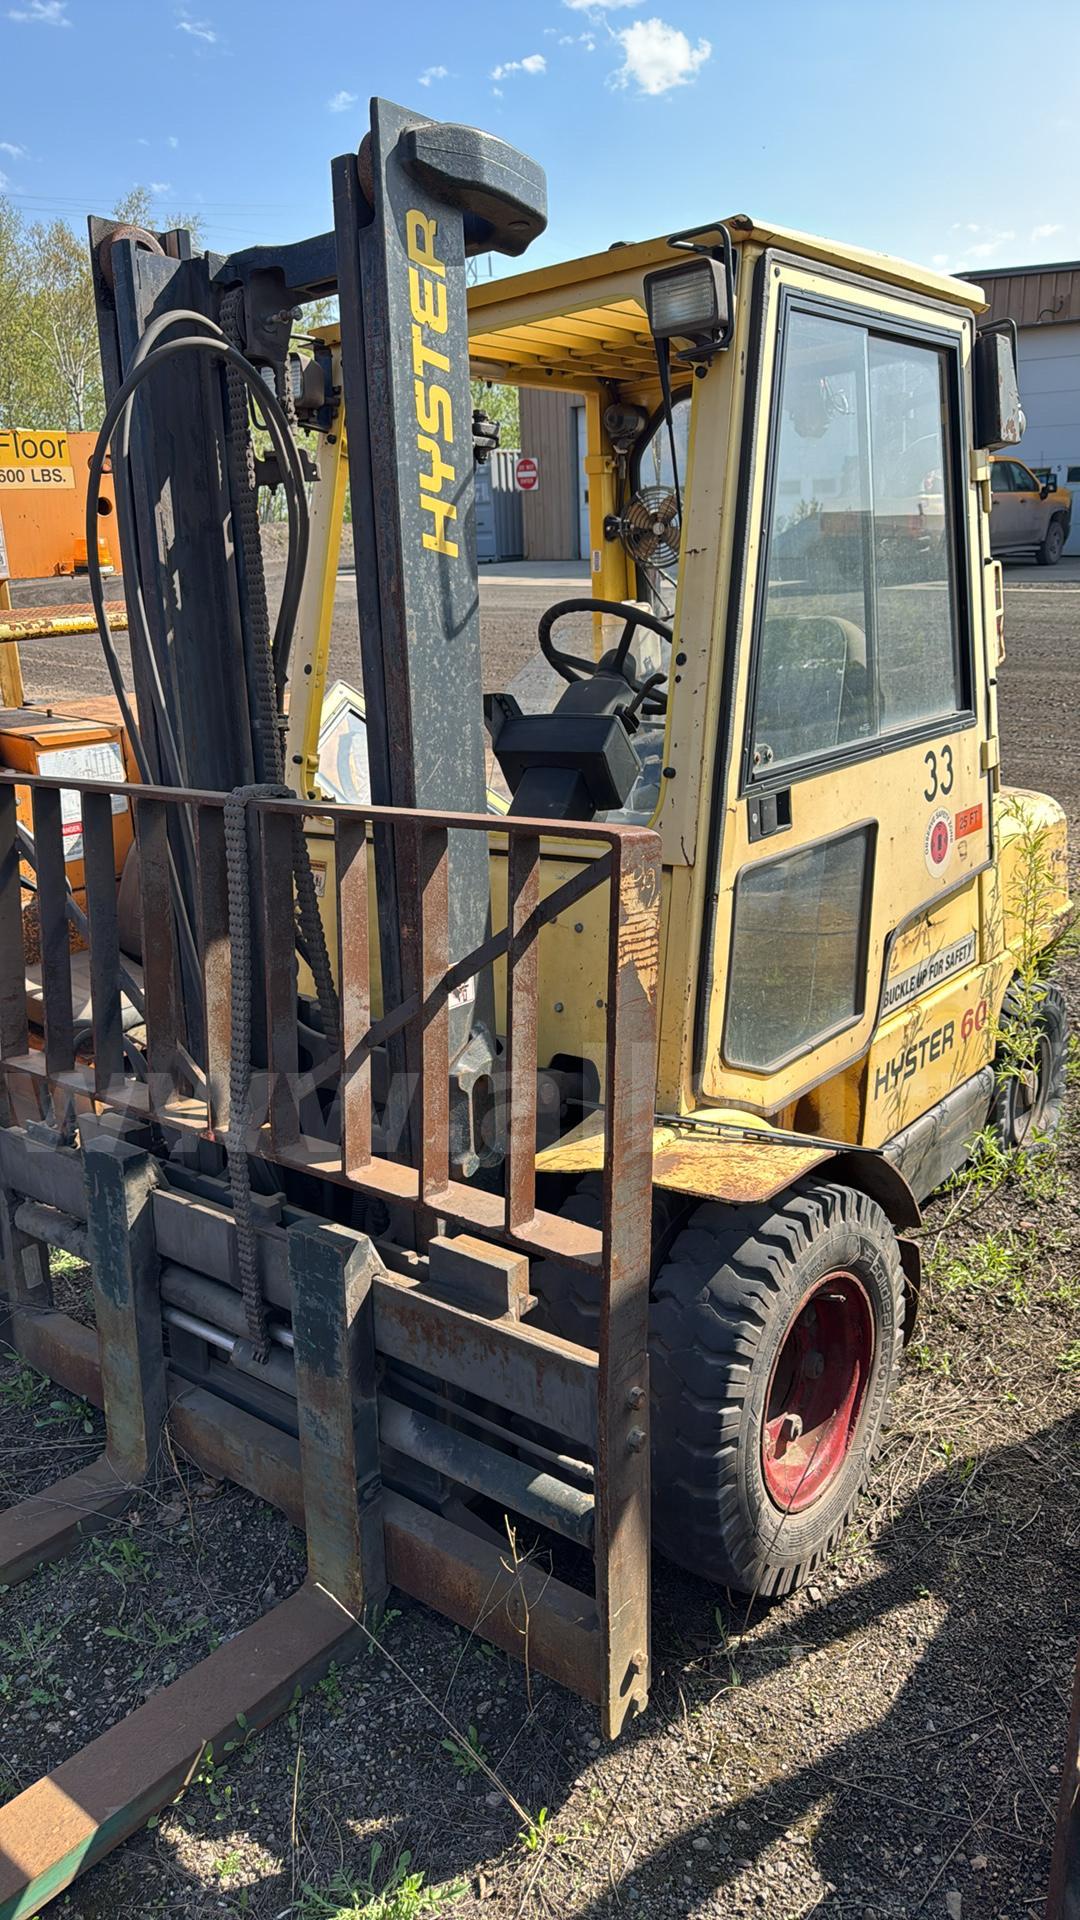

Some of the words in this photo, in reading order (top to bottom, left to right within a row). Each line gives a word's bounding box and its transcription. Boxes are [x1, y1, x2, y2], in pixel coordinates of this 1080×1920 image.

[406, 208, 459, 558] HYSTER
[31, 468, 66, 483] LBS.
[923, 744, 954, 803] 33
[959, 815, 968, 830] 25
[969, 810, 979, 826] FT
[883, 975, 915, 1008] BUCKLE
[915, 968, 928, 989] UP
[928, 958, 944, 981] FOR
[944, 939, 974, 971] SAFETY
[874, 1020, 954, 1101] HYSTER
[961, 1000, 987, 1041] 60
